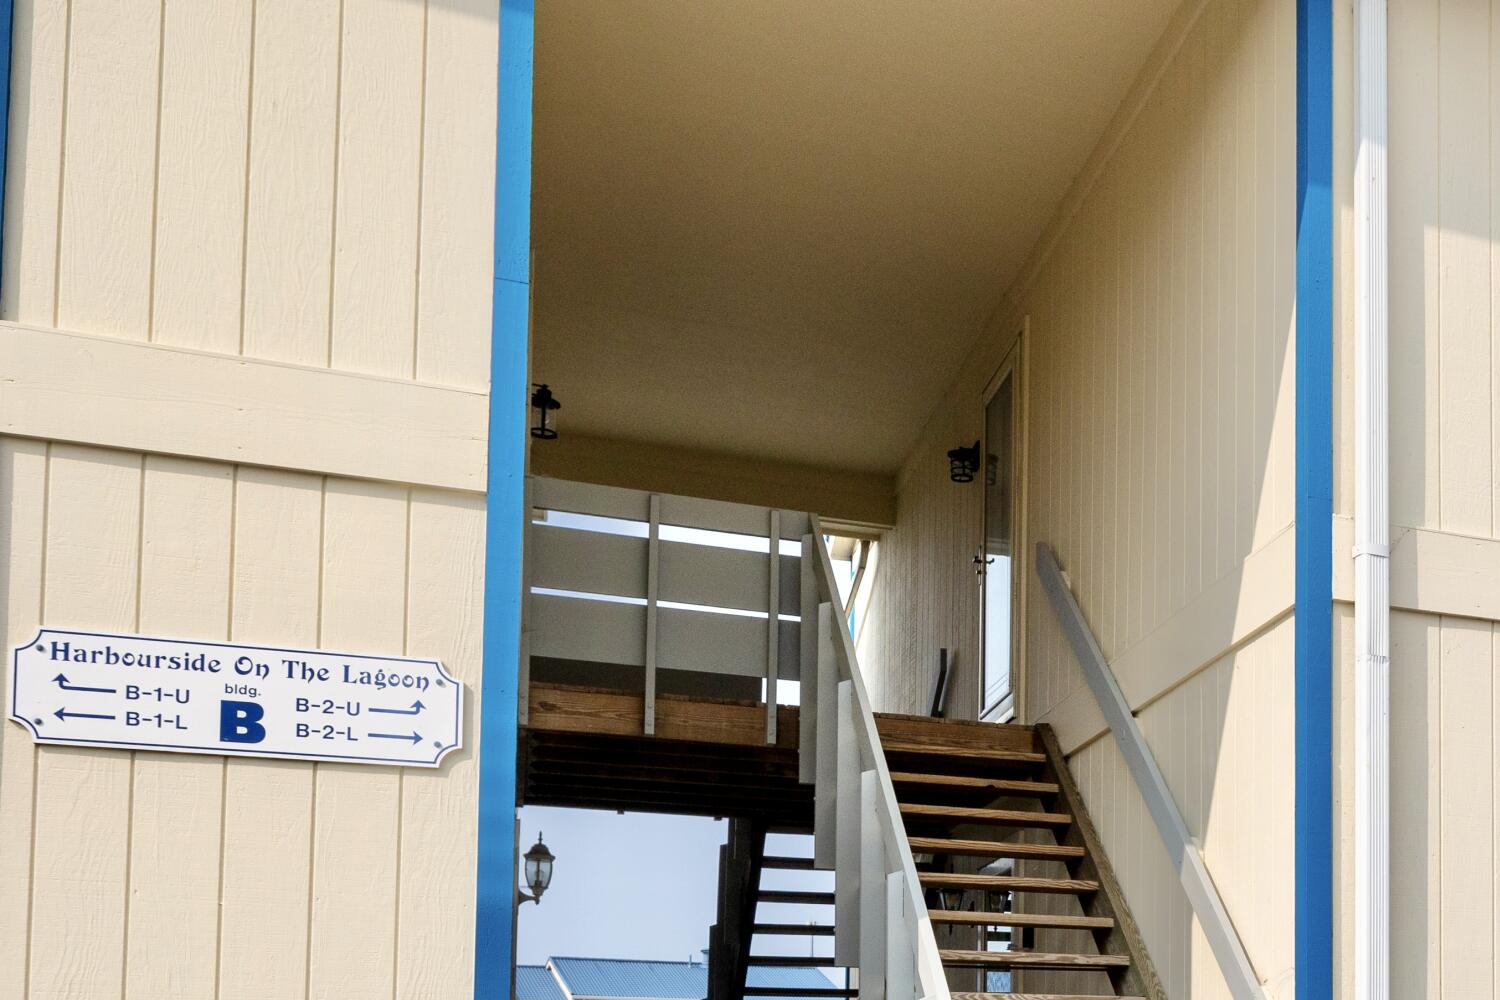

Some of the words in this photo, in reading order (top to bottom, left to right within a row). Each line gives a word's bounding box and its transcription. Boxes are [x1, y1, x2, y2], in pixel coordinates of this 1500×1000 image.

[50, 641, 221, 673] Harbourside
[234, 656, 270, 680] On
[281, 659, 330, 684] The
[343, 664, 430, 692] Lagoon
[125, 684, 190, 704] B-1-U
[224, 683, 261, 698] bldg.
[296, 697, 360, 717] B-2-U
[125, 711, 188, 730] B-1-L
[219, 699, 267, 744] B
[296, 723, 359, 741] B-2-L
